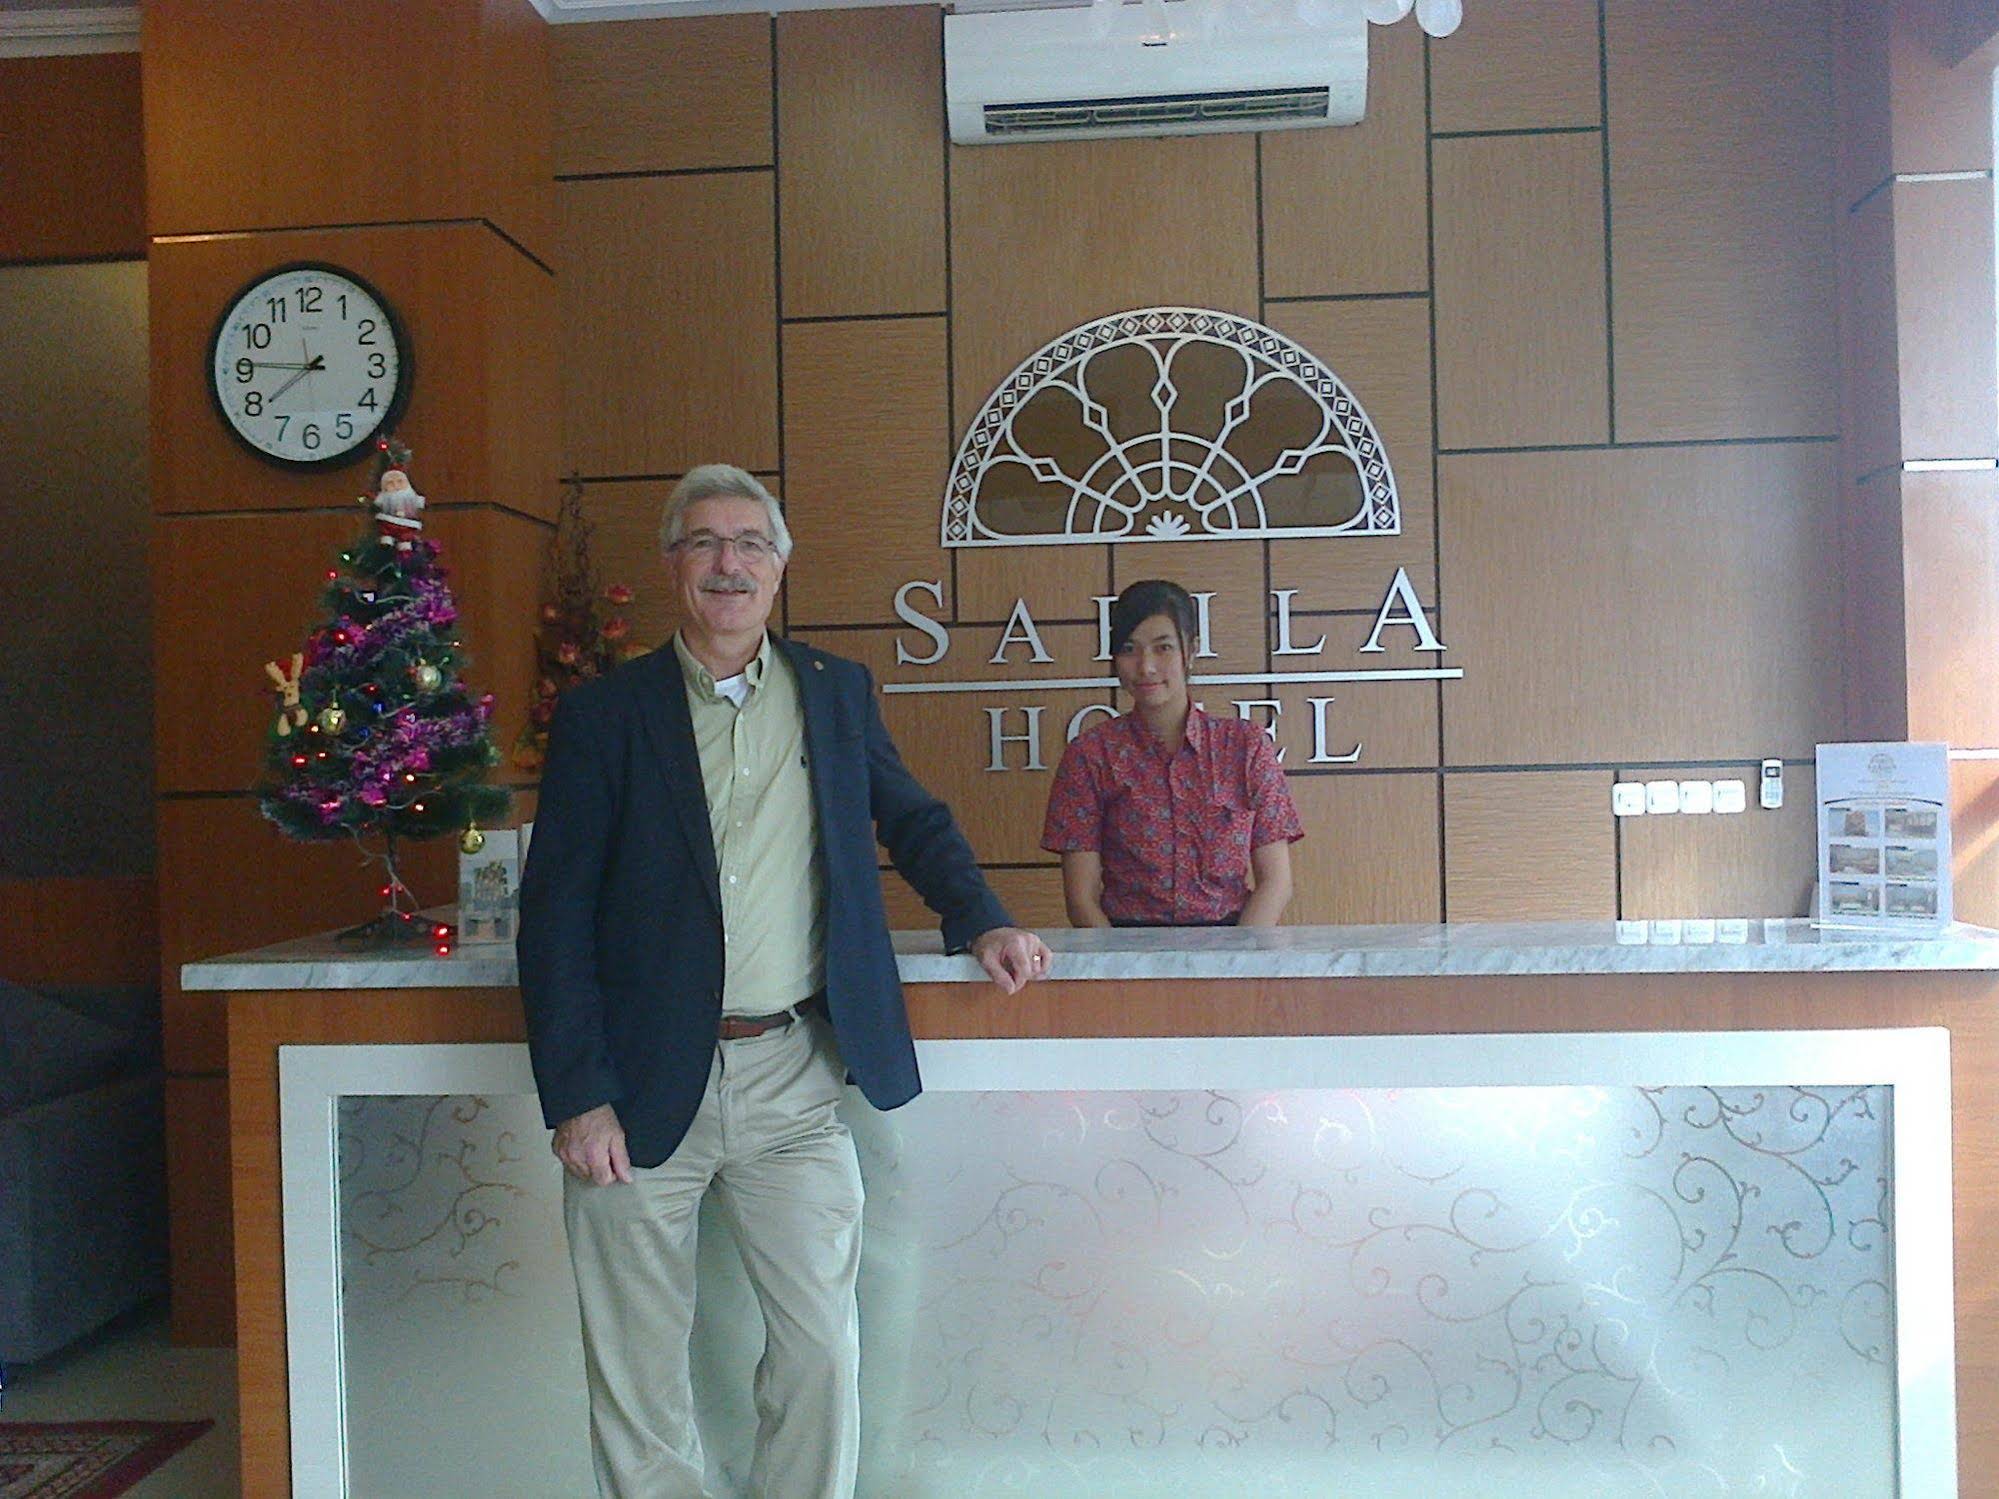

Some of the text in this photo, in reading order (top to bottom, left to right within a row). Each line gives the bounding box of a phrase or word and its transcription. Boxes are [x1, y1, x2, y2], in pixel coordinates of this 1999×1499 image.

[266, 297, 286, 323] 11
[295, 286, 323, 313] 12
[337, 294, 347, 321] 1
[242, 323, 271, 349] 10
[358, 319, 376, 345] 2
[236, 357, 254, 383] 9
[367, 353, 386, 379] 3
[244, 391, 263, 417] 8
[358, 388, 378, 412] 4
[274, 415, 291, 441] 7
[302, 424, 321, 450] 6
[336, 413, 353, 439] 5
